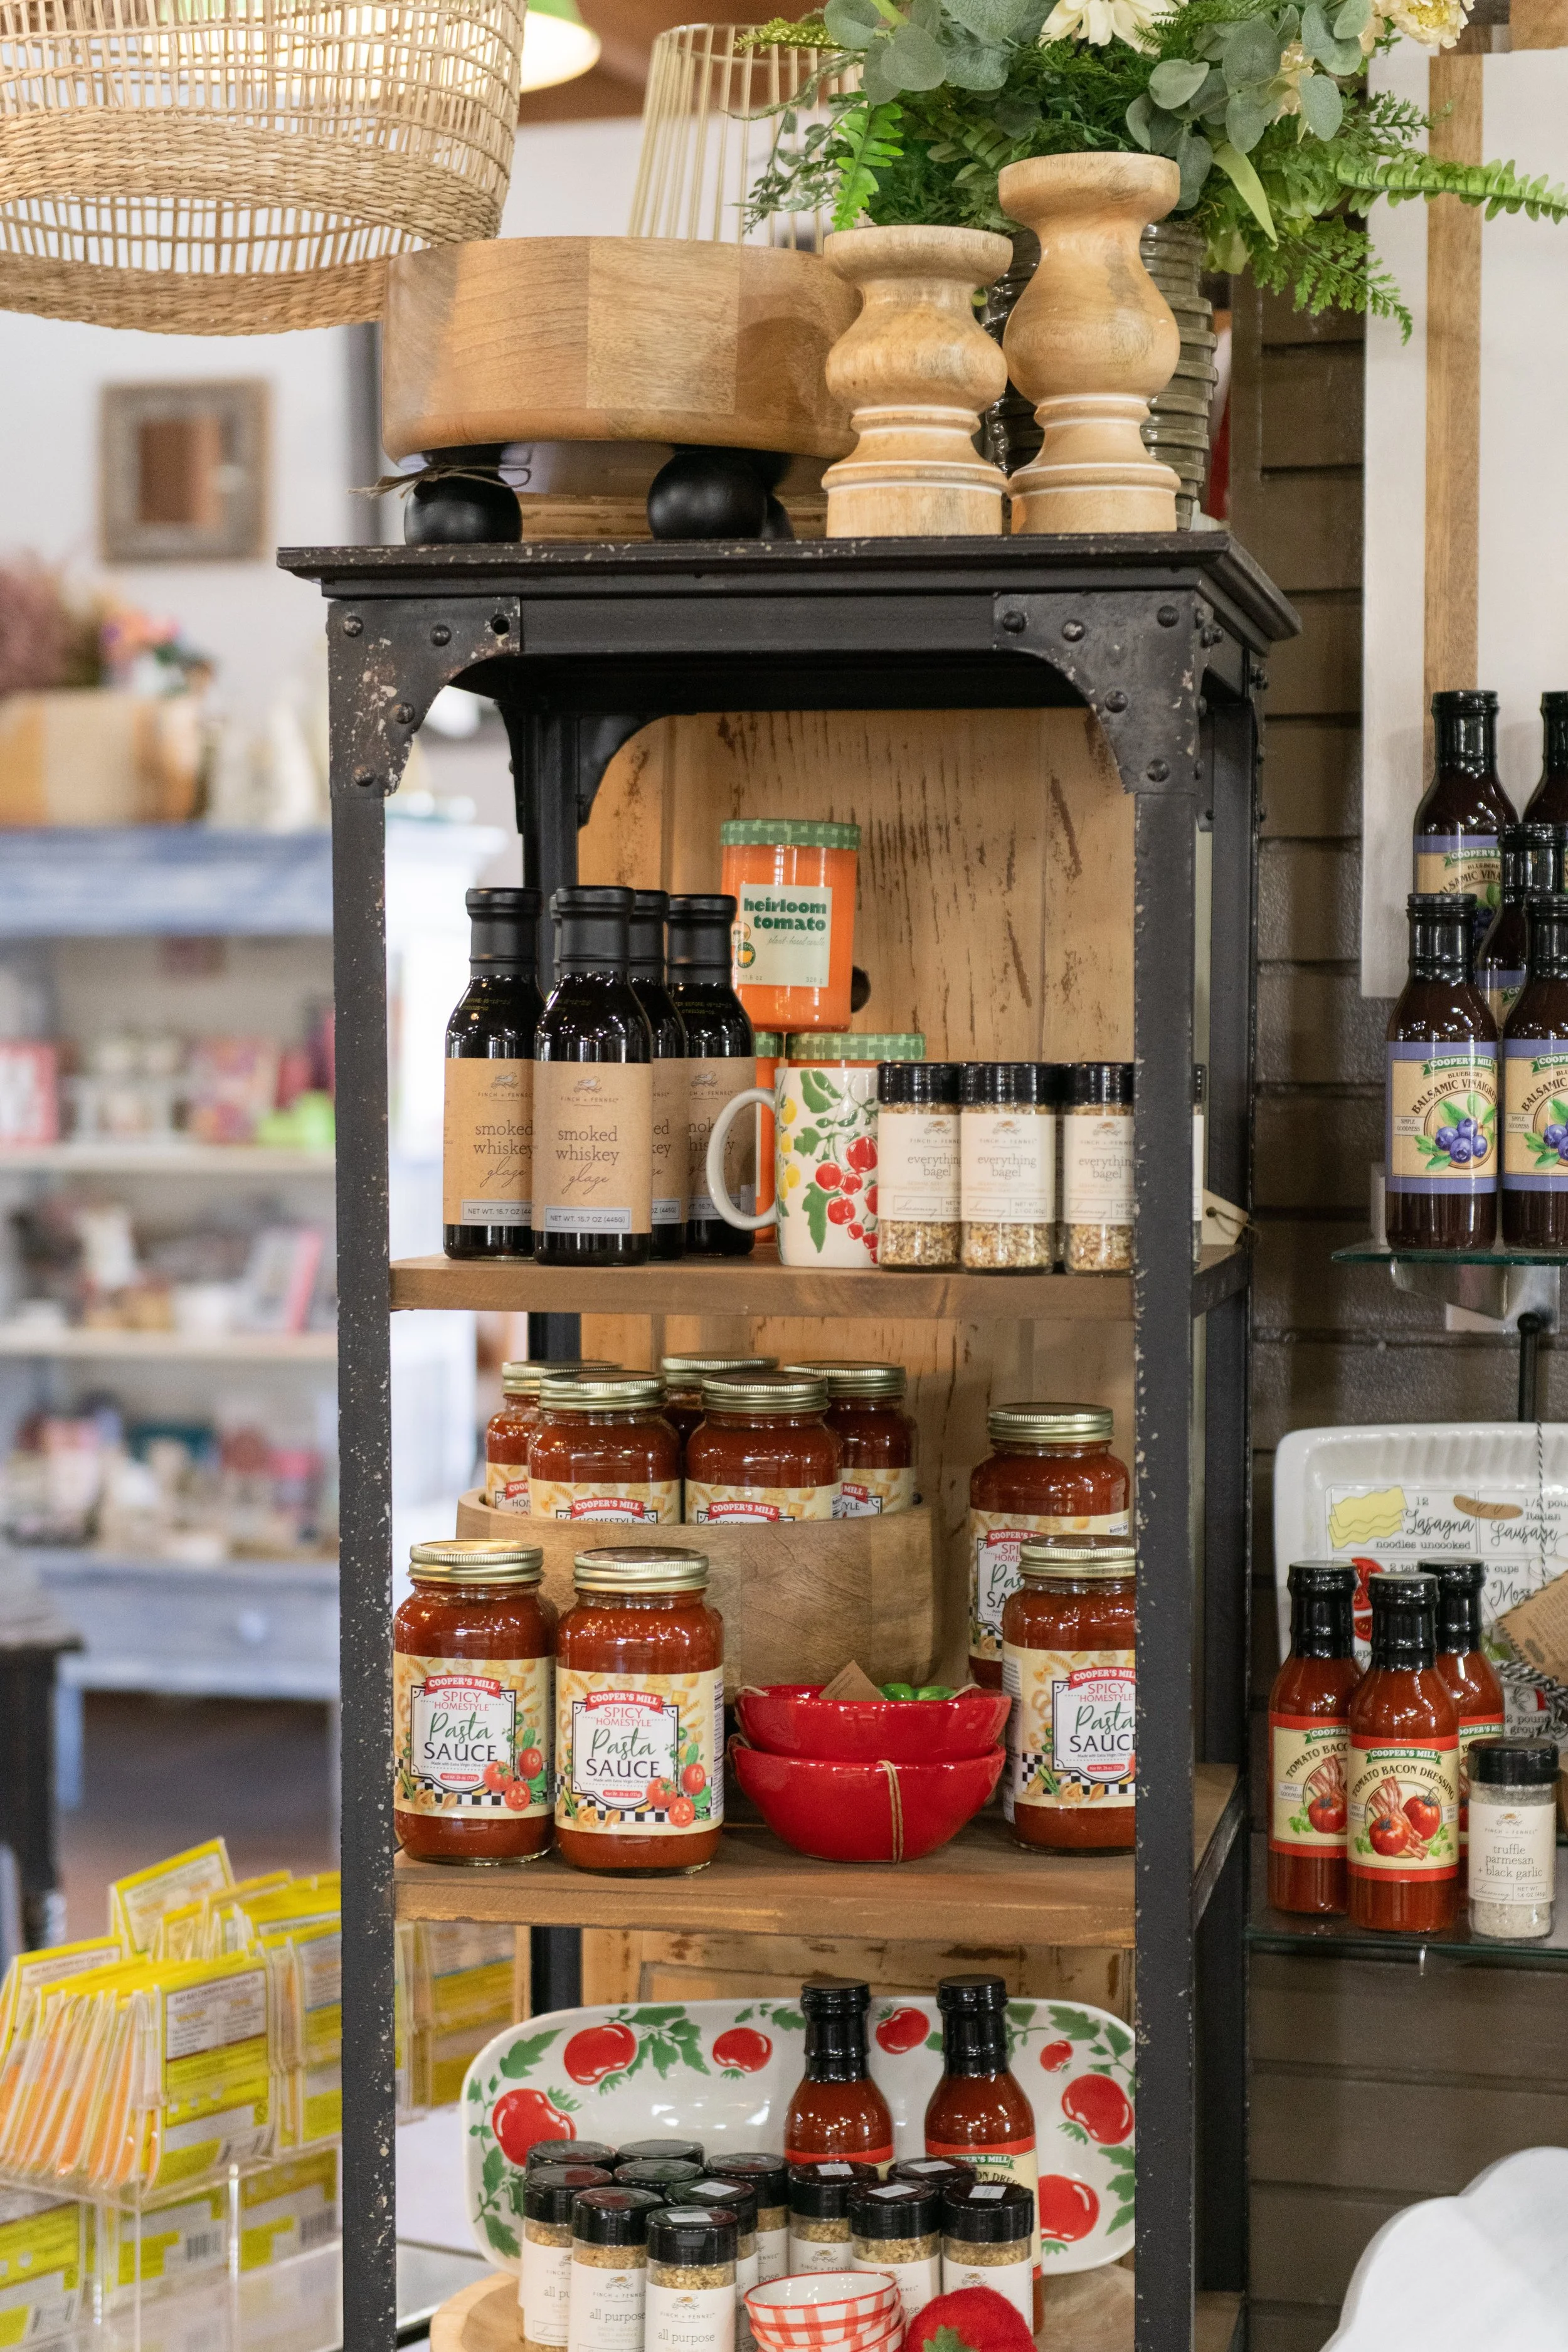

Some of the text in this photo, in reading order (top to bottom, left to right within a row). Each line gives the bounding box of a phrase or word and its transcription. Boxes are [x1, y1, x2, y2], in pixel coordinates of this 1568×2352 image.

[1451, 849, 1495, 859] COOPER'S
[1439, 870, 1479, 894] ALSAMIC
[743, 897, 827, 914] heirloom
[753, 914, 827, 931] tomato
[1431, 1057, 1493, 1067] COOPER'S MILL
[1412, 1079, 1459, 1115] BALSAMIC
[1521, 1078, 1567, 1112] BALSAMIC
[475, 1120, 532, 1136] smoked
[558, 1125, 618, 1142] smoked
[473, 1139, 532, 1159] whiskey
[556, 1145, 620, 1166] whiskey
[908, 1153, 961, 1167] everythin
[978, 1153, 1037, 1168] everything
[480, 1155, 527, 1188] glaze
[561, 1162, 610, 1195] glaze
[923, 1164, 951, 1179] bagel
[992, 1164, 1022, 1180] bagel
[1093, 1166, 1122, 1182] bagel
[844, 1485, 863, 1495] MILL
[575, 1500, 640, 1510] COOPER'S MILL
[1416, 1496, 1429, 1506] 12
[712, 1503, 775, 1515] COOPER'S MILL
[1406, 1508, 1475, 1540] Lasagna
[990, 1532, 1029, 1540] COOPER'S
[1376, 1540, 1471, 1550] noodles uncooked
[1390, 1563, 1397, 1572] 2
[1495, 1565, 1519, 1575] cups
[1074, 1669, 1117, 1681] COOPER'S
[429, 1678, 496, 1690] COOPER'S MILL
[1088, 1683, 1126, 1694] SPICY
[442, 1691, 482, 1702] SPICY
[590, 1692, 658, 1705] COOPER'S MILL
[1079, 1694, 1133, 1702] HOMESTYLE
[434, 1702, 489, 1711] HOMESTYLE
[604, 1707, 644, 1718] SPICY
[596, 1718, 652, 1727] HOMESTYLE
[1074, 1702, 1136, 1735] Pasta
[1506, 1714, 1513, 1723] 2
[429, 1711, 494, 1744] Pasta
[591, 1727, 657, 1761] Pasta
[424, 1742, 498, 1762] SAUCE
[1416, 1751, 1437, 1759] MILL
[586, 1758, 661, 1778] SAUCE
[1286, 1748, 1320, 1778] TOMATO
[1352, 1764, 1455, 1801] TOMATO BACON DRESSING
[1493, 1843, 1526, 1855] truffle
[1485, 1855, 1534, 1866] parmesan
[1486, 1865, 1513, 1877] black
[1516, 1867, 1543, 1881] garlic
[544, 2286, 555, 2297] all
[590, 2308, 646, 2324] all purpose
[658, 2328, 715, 2346] all purpose
